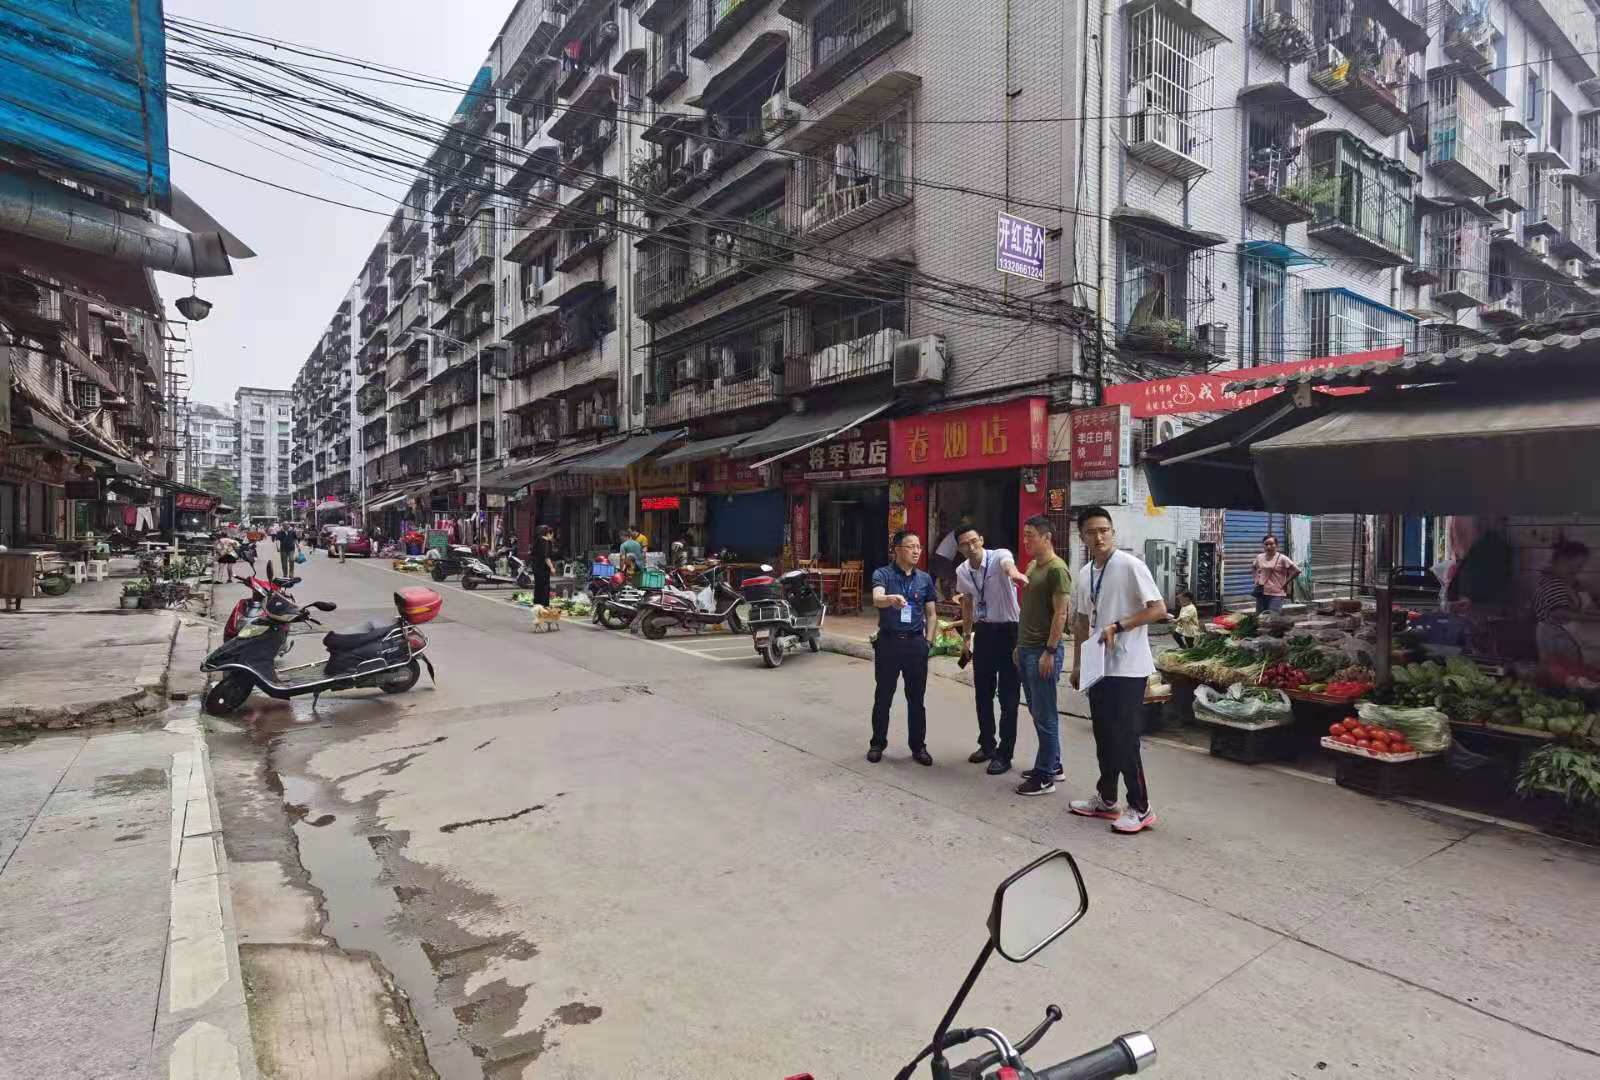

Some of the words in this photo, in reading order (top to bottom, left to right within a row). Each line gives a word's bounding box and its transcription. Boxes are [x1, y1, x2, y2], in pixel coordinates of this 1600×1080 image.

[1000, 217, 1043, 259] 开红房介
[808, 440, 888, 470] 将军饭店
[904, 415, 1008, 463] 卷烟店
